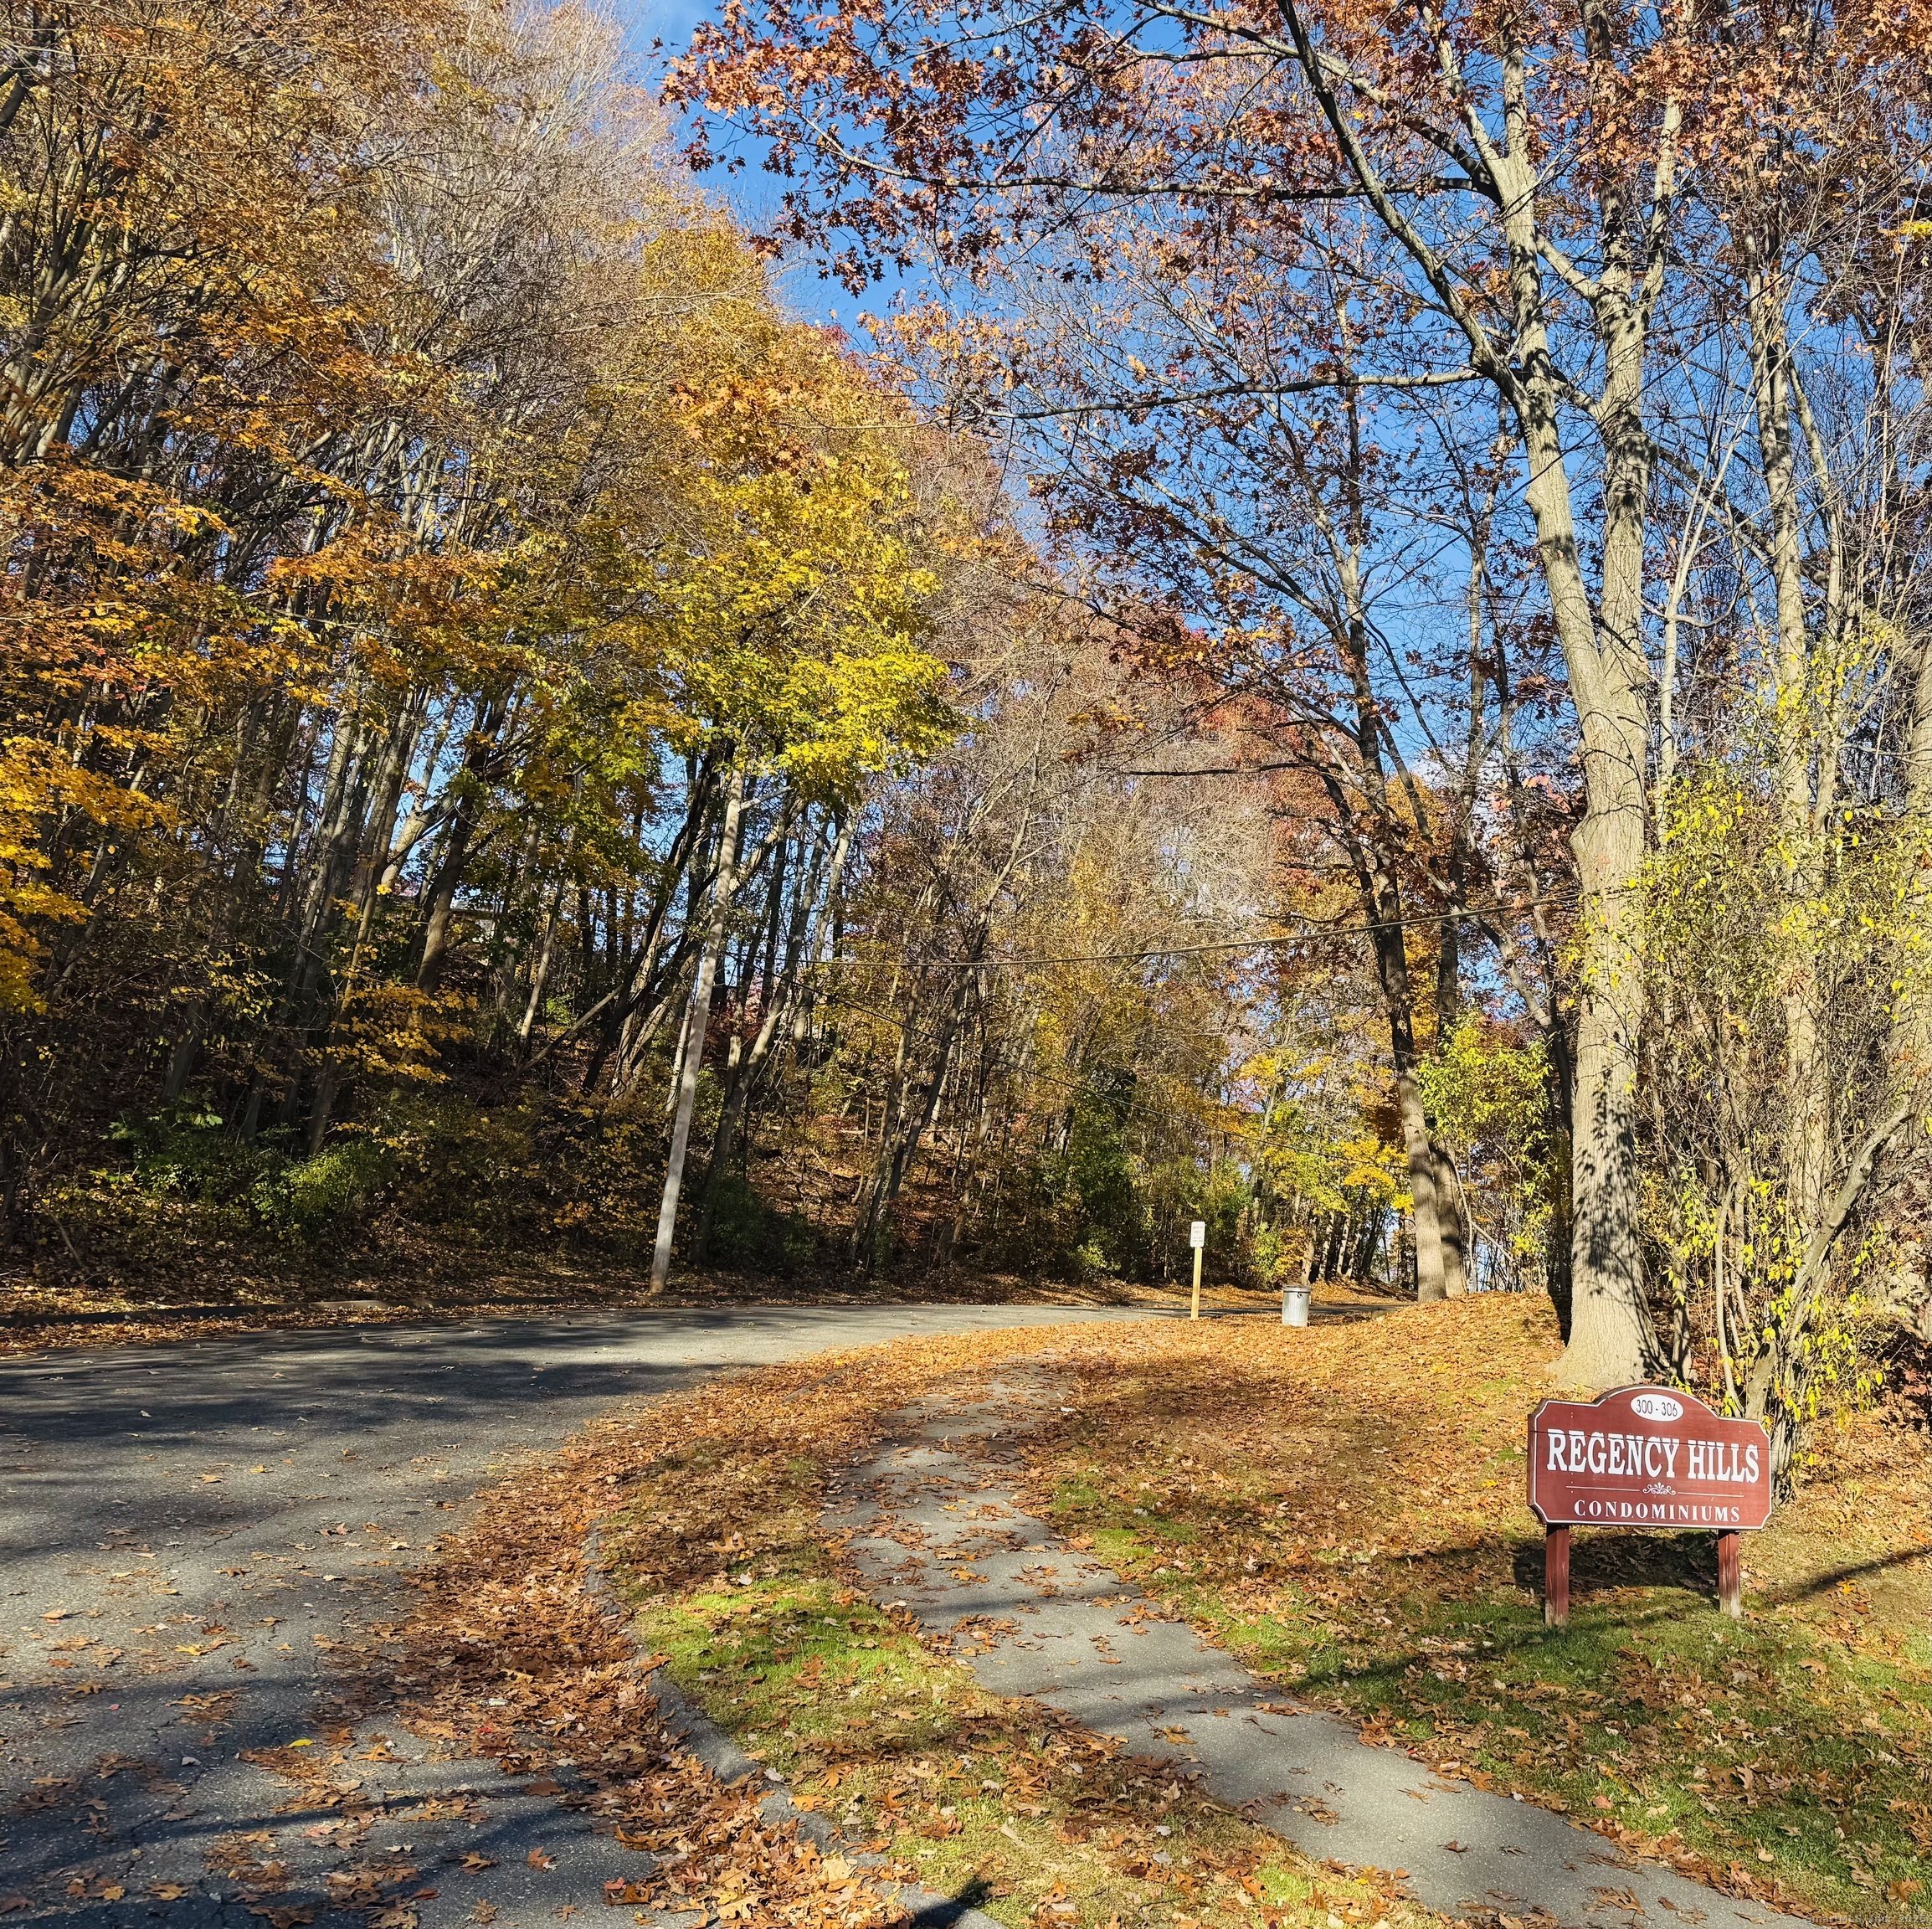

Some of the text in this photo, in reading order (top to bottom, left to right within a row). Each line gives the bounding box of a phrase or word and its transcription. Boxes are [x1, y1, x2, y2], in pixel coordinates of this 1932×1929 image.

[1636, 1399, 1653, 1415] 300
[1661, 1402, 1678, 1417] 306
[1546, 1428, 1760, 1484] REGENCY HILLS
[1574, 1499, 1740, 1523] CONDOMINIUMS
